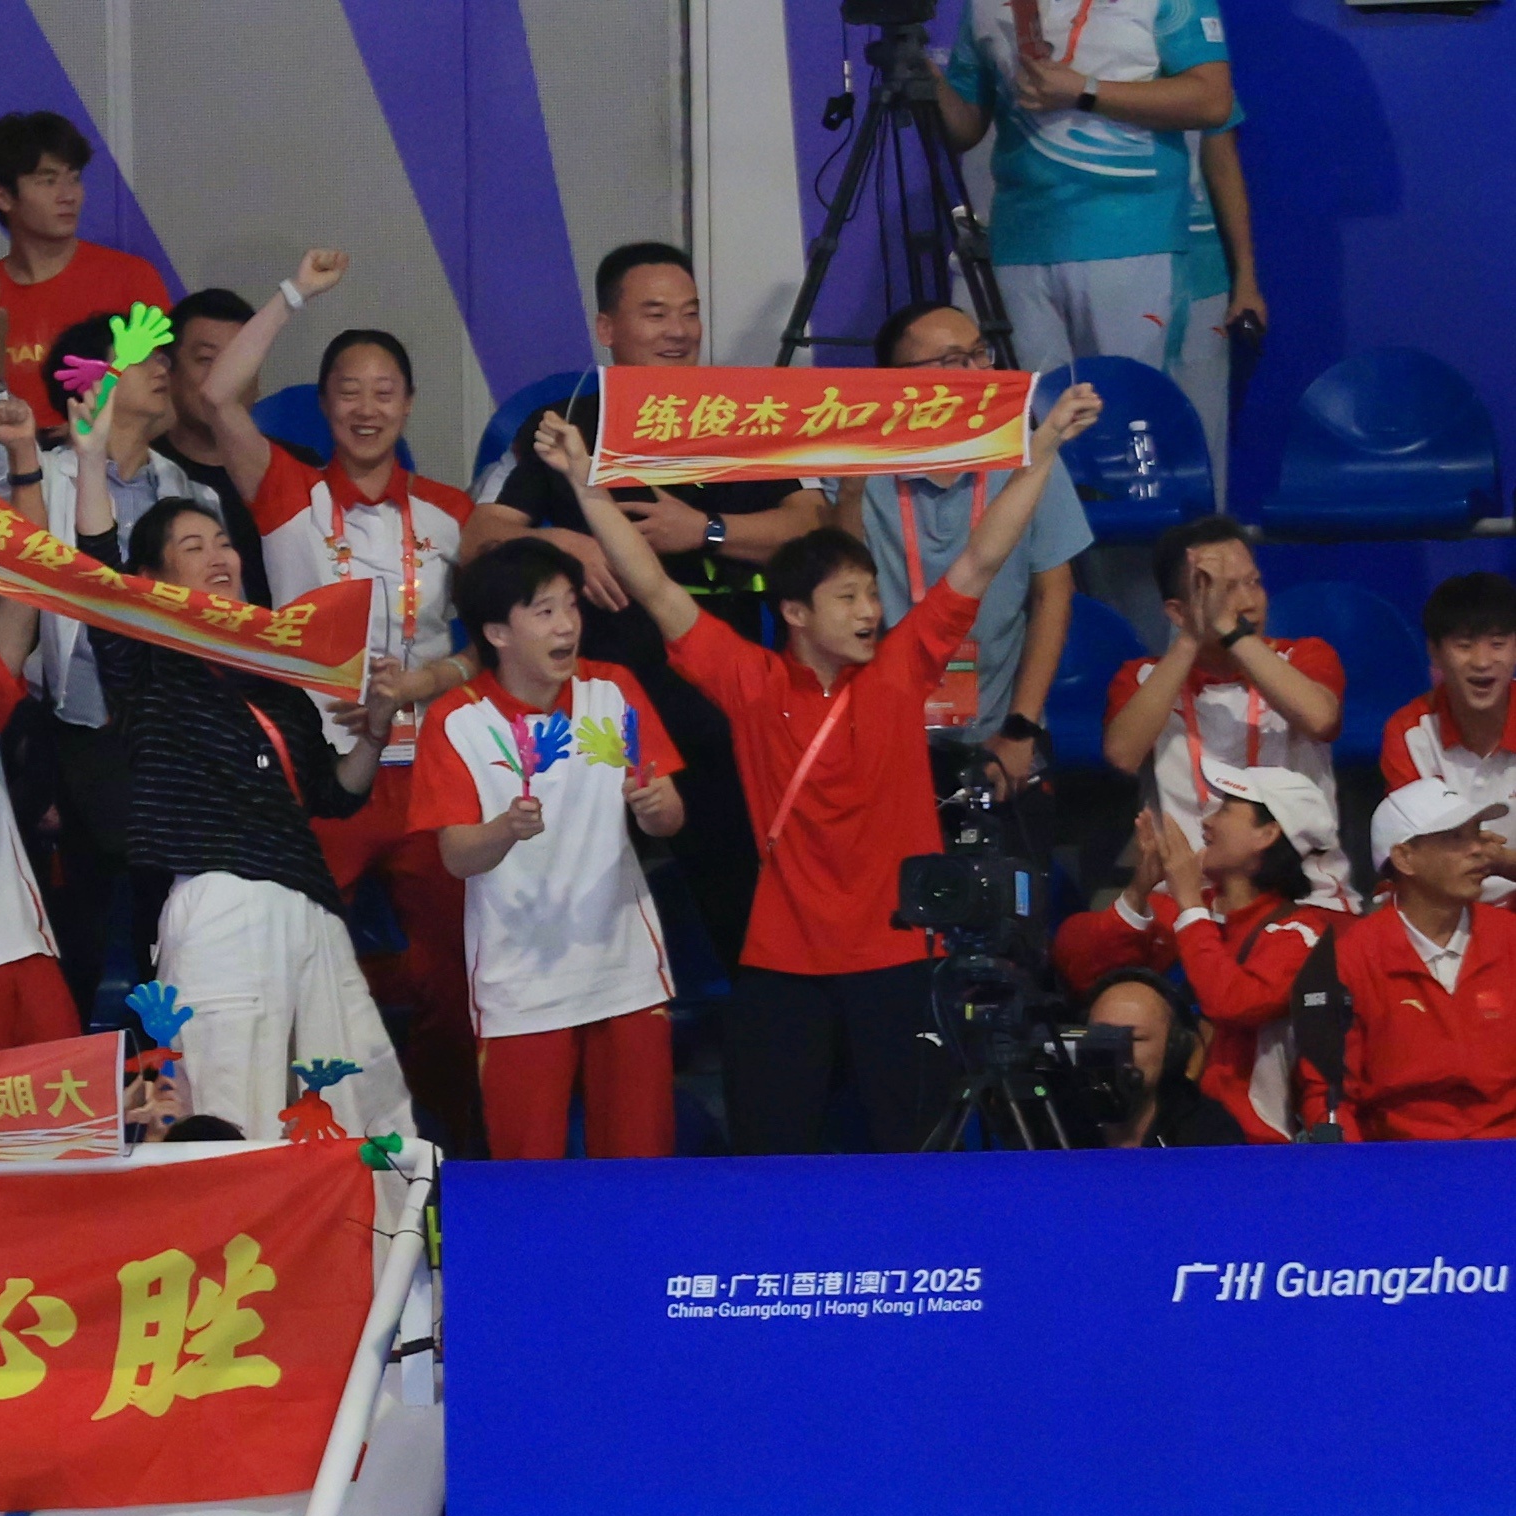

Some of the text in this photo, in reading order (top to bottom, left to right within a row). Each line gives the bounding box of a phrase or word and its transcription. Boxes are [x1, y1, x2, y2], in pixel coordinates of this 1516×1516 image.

[632, 384, 995, 442] 练俊杰加油！
[912, 1268, 982, 1293] 2025
[1172, 1256, 1509, 1305] 广州 Guangzhou
[824, 1300, 869, 1317] Hong
[872, 1298, 913, 1316] Kong
[927, 1297, 982, 1312] Macao
